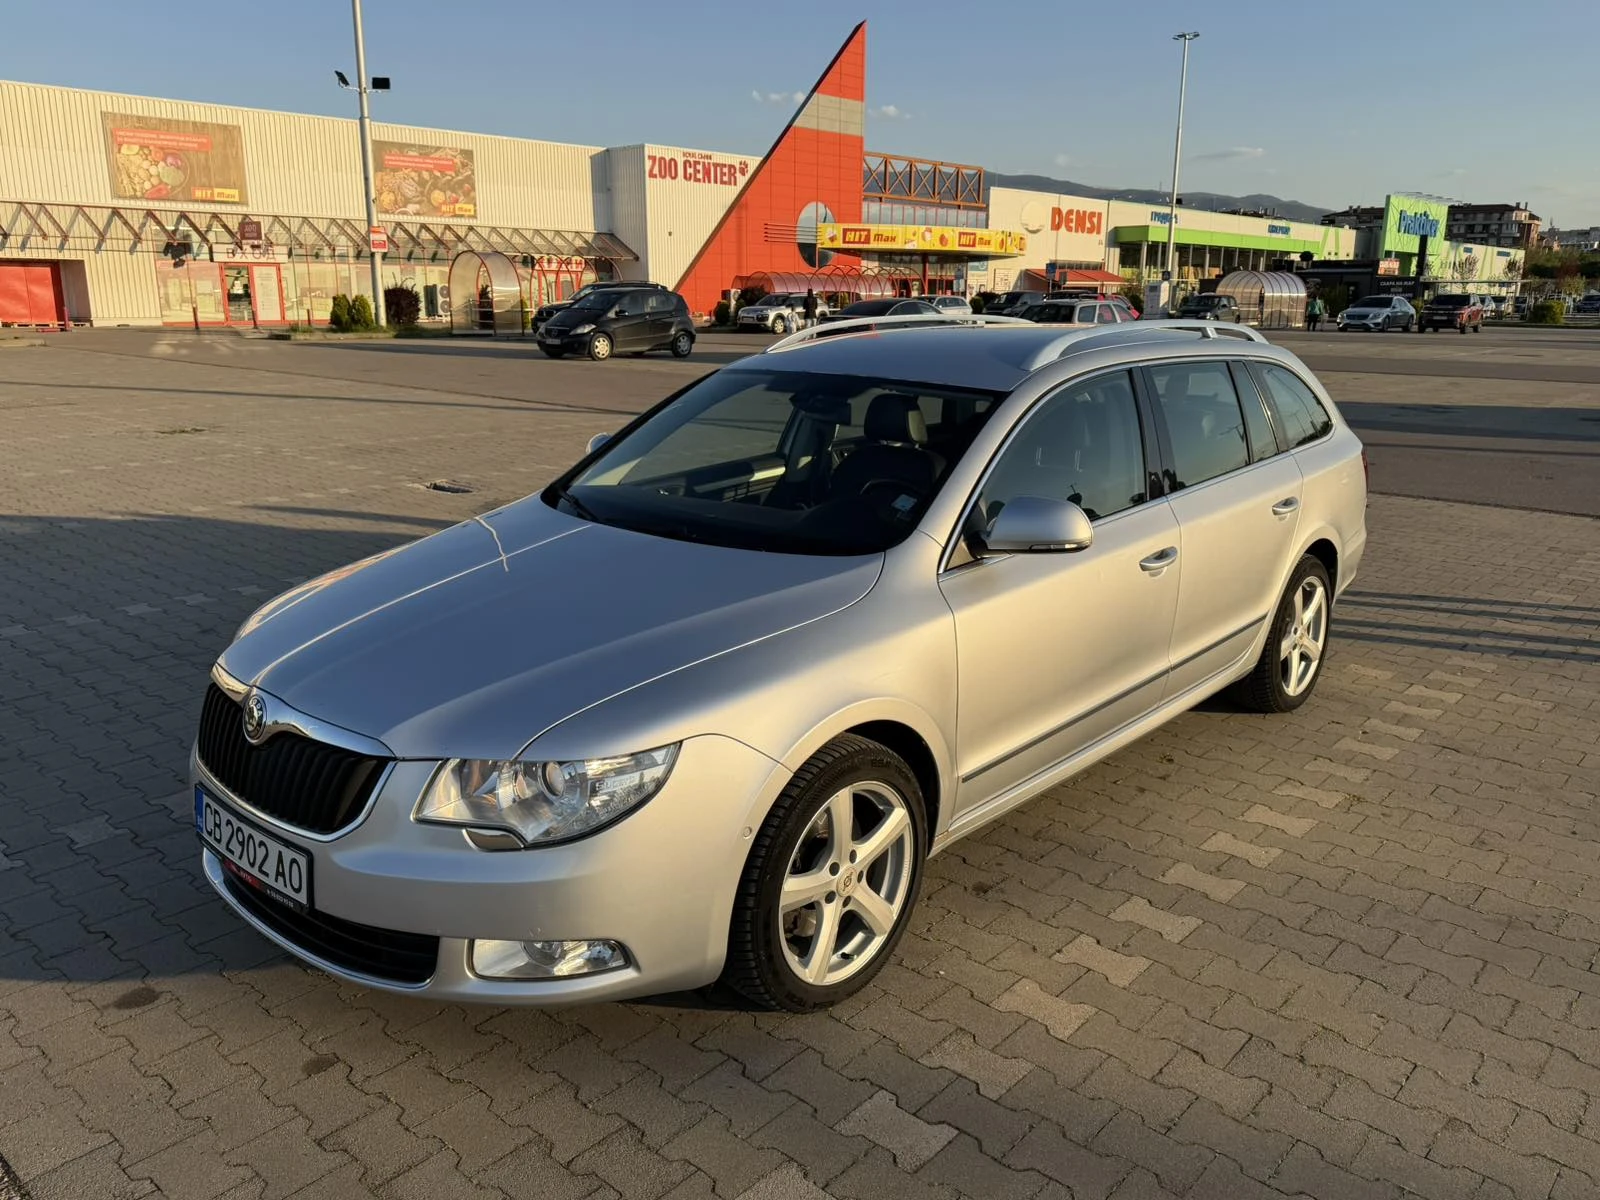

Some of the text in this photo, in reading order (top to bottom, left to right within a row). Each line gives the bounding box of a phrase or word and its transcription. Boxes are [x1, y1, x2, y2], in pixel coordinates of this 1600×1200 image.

[647, 155, 737, 187] ZOO CENTER
[1050, 206, 1103, 235] DENSI
[1398, 209, 1440, 238] Praktiker
[845, 230, 868, 242] HIT
[960, 233, 976, 247] HIT
[204, 802, 222, 845] CB
[225, 818, 270, 879] 2902
[274, 850, 303, 894] AO
